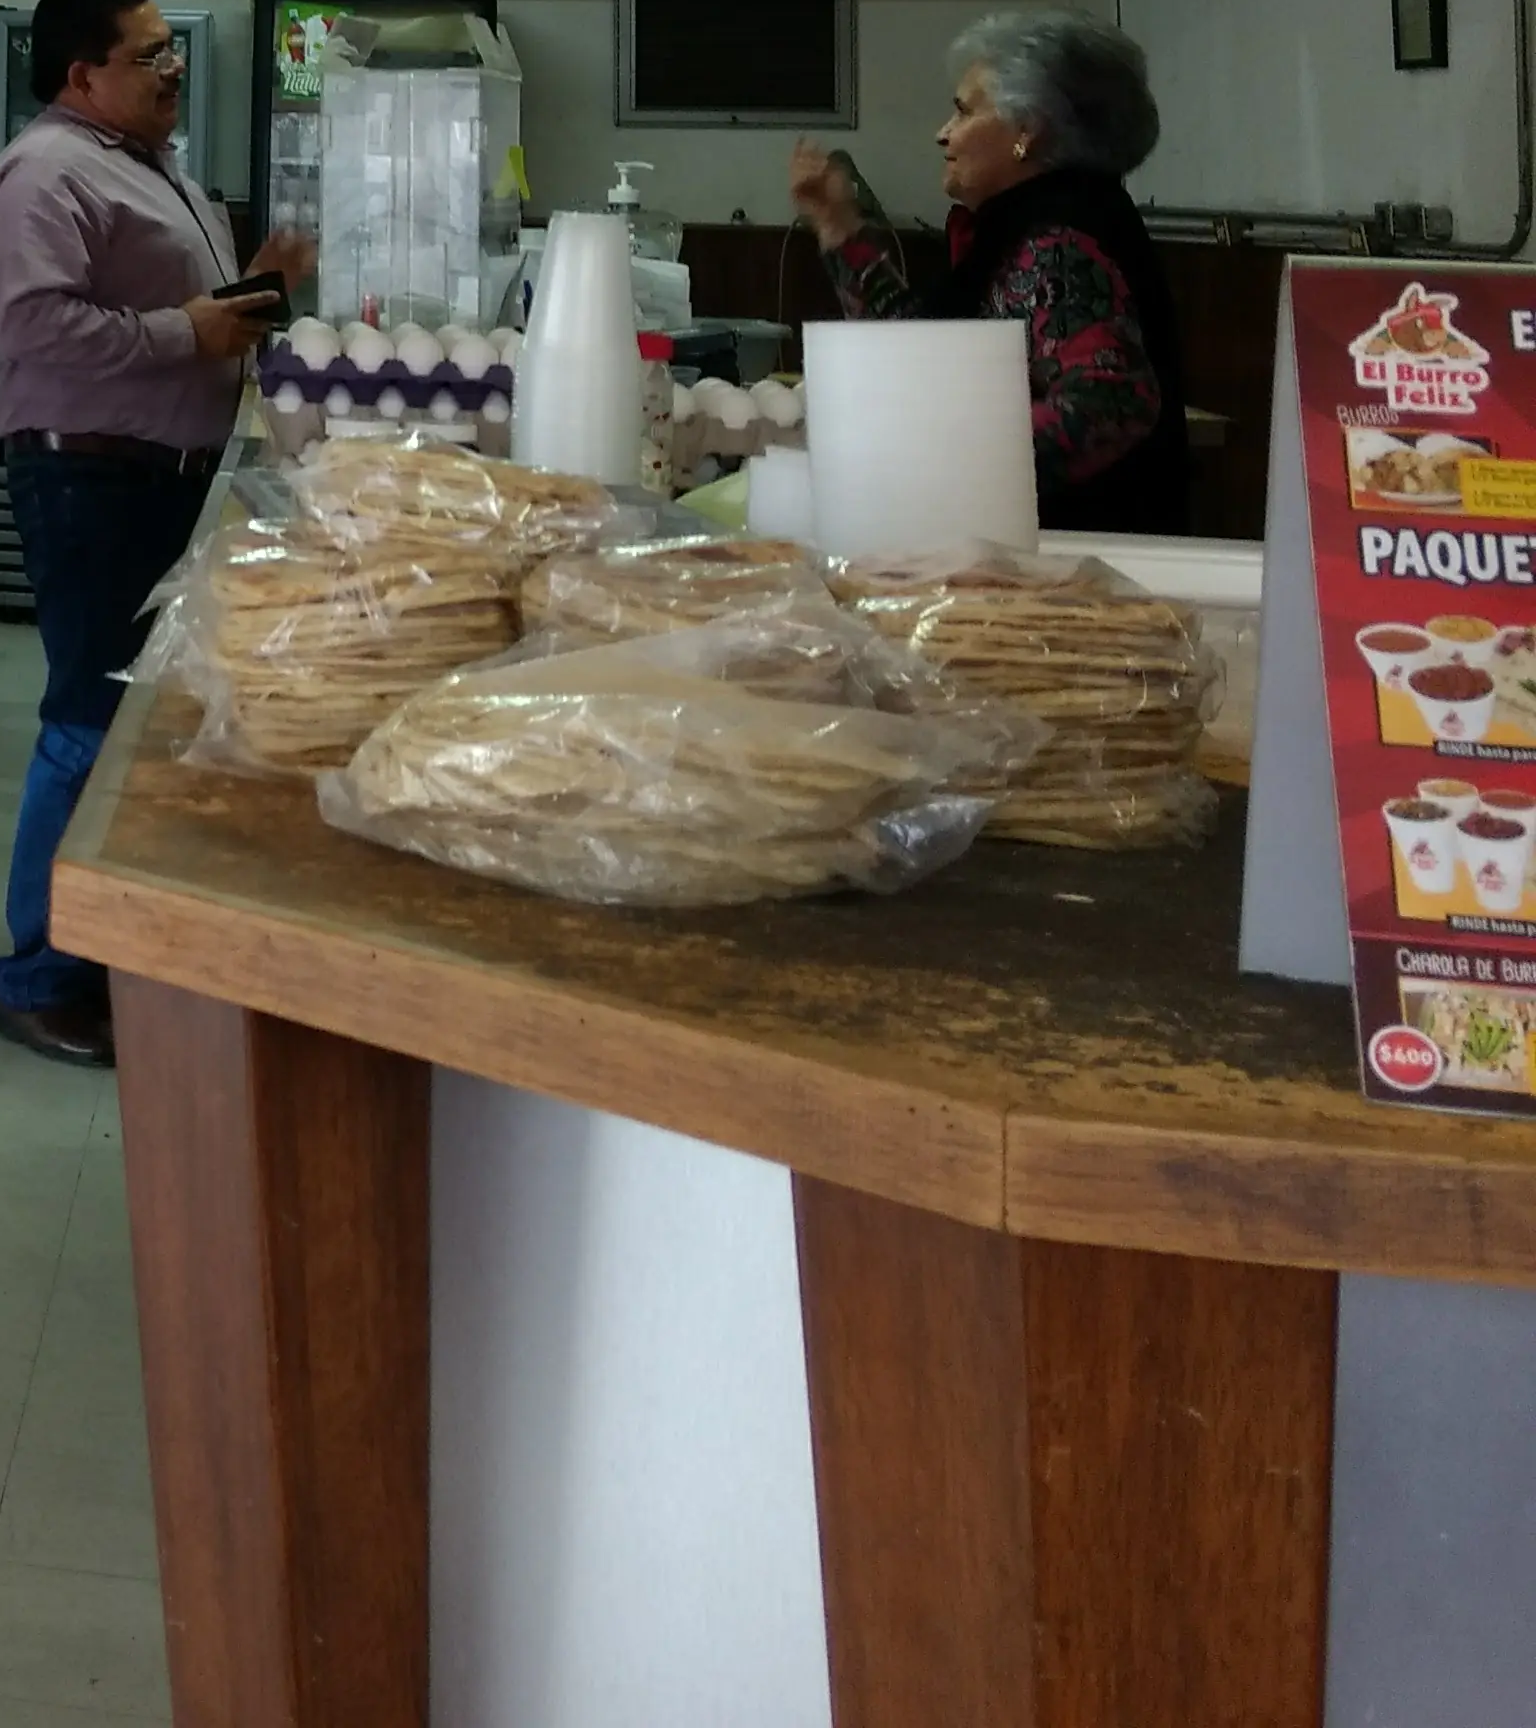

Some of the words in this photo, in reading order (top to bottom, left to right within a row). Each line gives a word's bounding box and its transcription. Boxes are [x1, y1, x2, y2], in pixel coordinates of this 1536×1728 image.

[1510, 309, 1536, 351] E
[1363, 361, 1386, 381] El
[1396, 361, 1482, 386] Burro
[1394, 383, 1463, 407] Feliz
[1395, 947, 1470, 976] CHAROLA
[1476, 959, 1496, 981] DE
